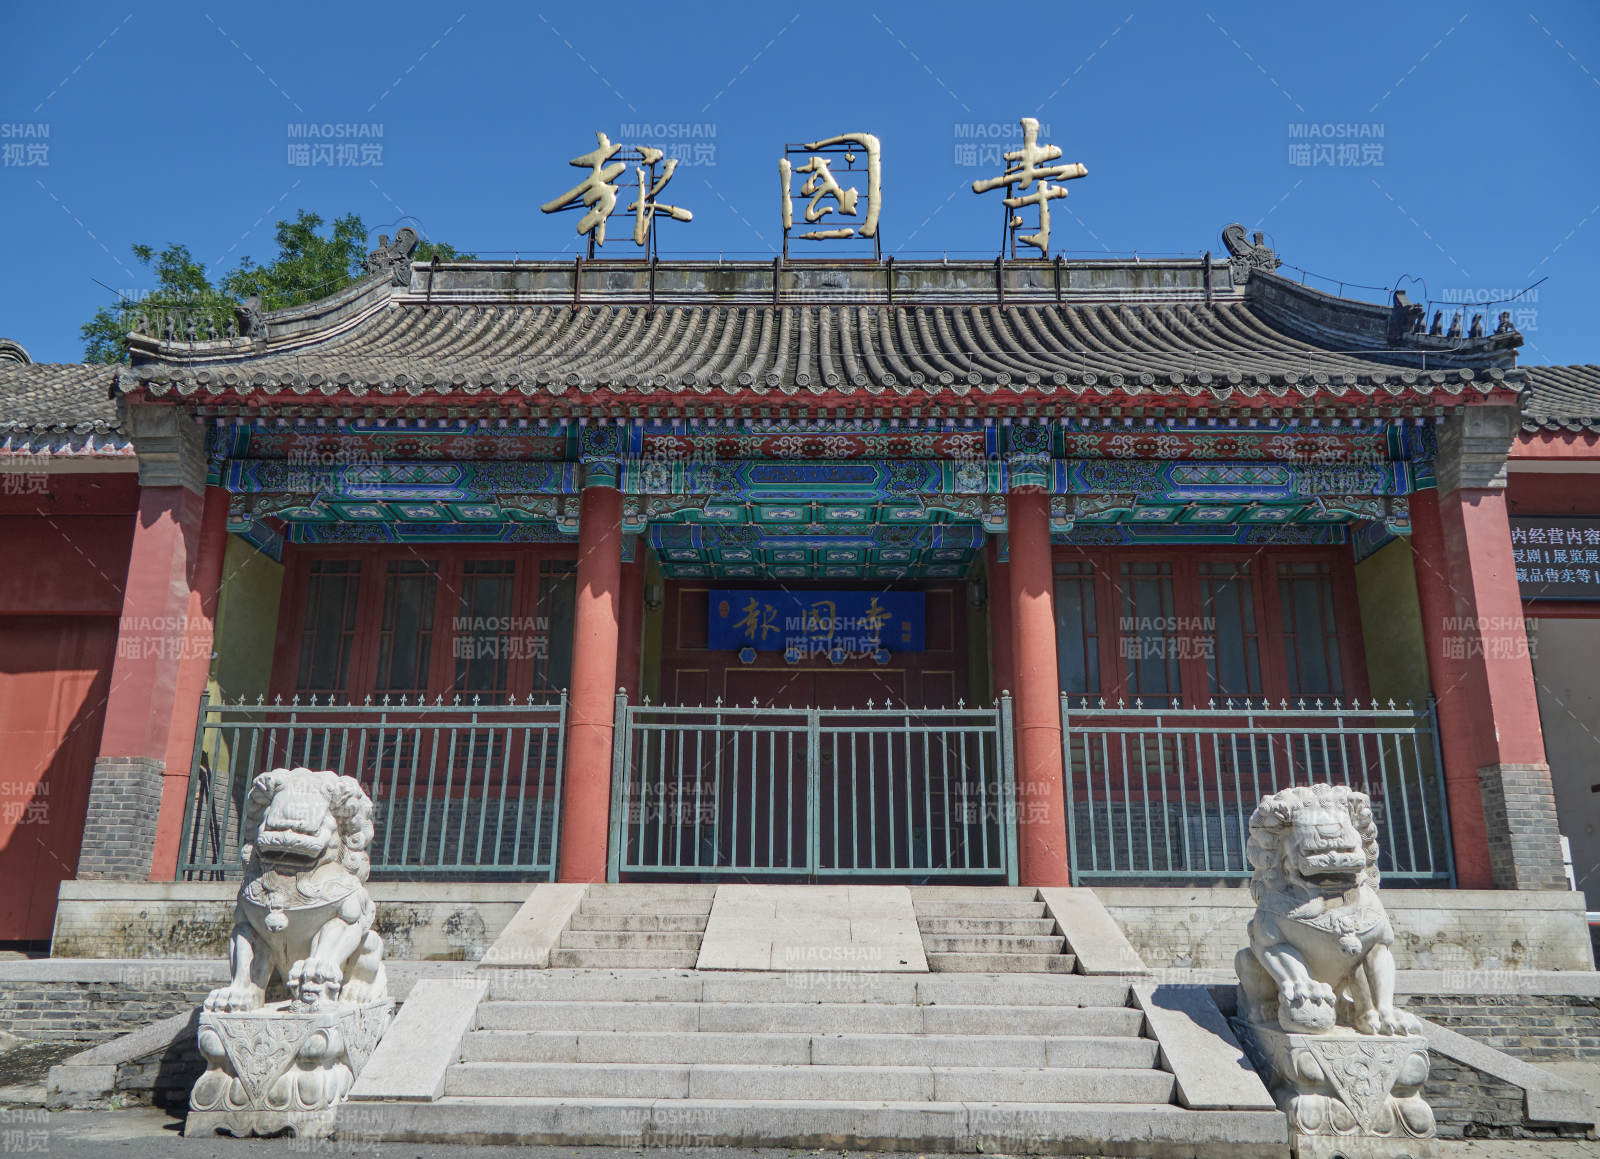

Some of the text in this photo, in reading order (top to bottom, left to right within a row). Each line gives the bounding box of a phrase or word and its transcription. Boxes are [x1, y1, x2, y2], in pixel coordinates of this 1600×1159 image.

[1511, 527, 1600, 544] 内经营内容
